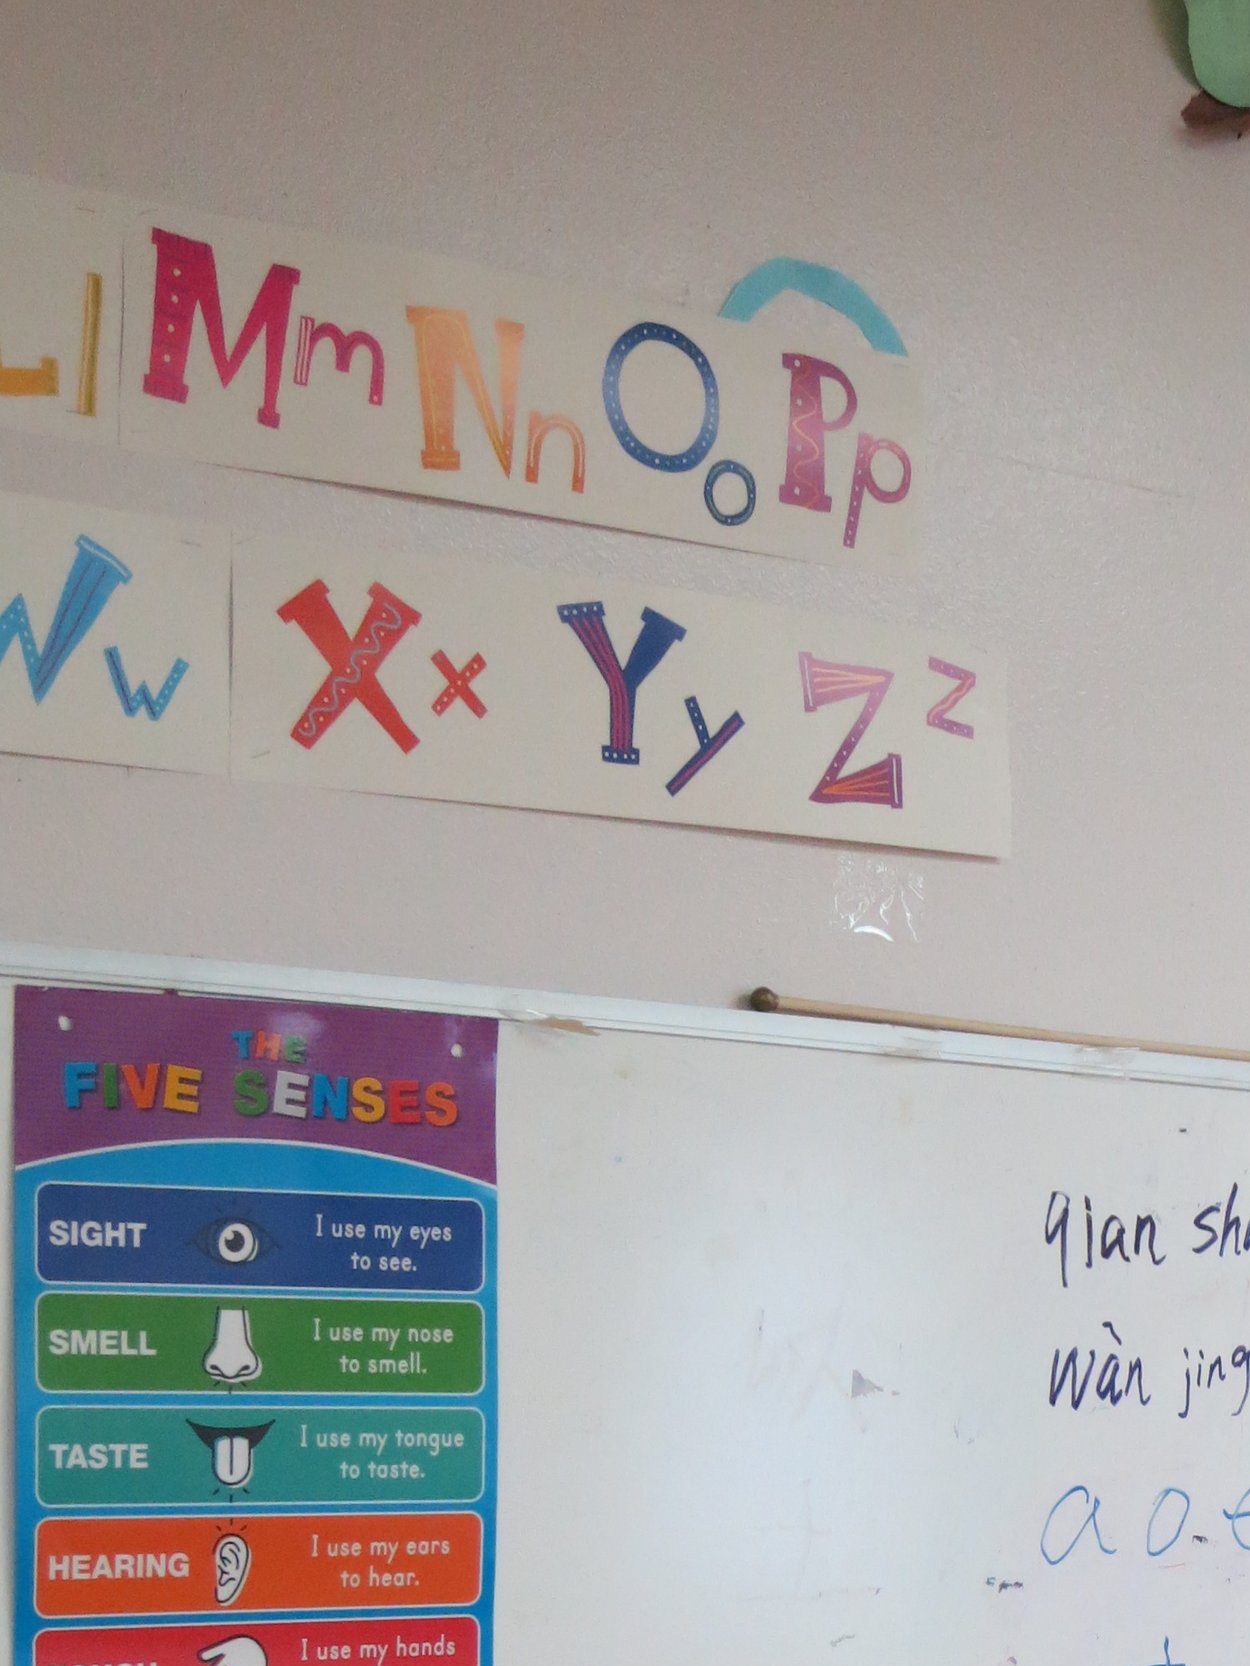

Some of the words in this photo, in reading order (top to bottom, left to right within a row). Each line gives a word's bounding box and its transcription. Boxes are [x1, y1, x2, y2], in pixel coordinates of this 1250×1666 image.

[232, 1029, 308, 1063] THE
[62, 1061, 202, 1114] FIVE
[232, 1069, 458, 1127] SENSES
[48, 1219, 147, 1248] SIGHT
[316, 1214, 323, 1237] I
[332, 1223, 366, 1238] use
[374, 1224, 402, 1248] my
[410, 1225, 452, 1249] eyes
[1045, 1190, 1167, 1288] qian
[351, 1252, 371, 1270] to
[379, 1256, 417, 1271] see.
[49, 1330, 157, 1355] SMELL
[314, 1318, 320, 1341] I
[329, 1327, 364, 1341] use
[372, 1327, 400, 1350] my
[408, 1328, 454, 1343] nose
[339, 1355, 360, 1373] to
[368, 1352, 427, 1374] smell.
[301, 1424, 307, 1447] I
[317, 1433, 350, 1447] use
[359, 1433, 387, 1456] my
[395, 1430, 464, 1456] tongue
[48, 1443, 149, 1469] TASTE
[340, 1461, 360, 1479] to
[368, 1461, 425, 1478] taste.
[1040, 1484, 1118, 1565] a
[1145, 1487, 1191, 1556] o
[312, 1534, 319, 1557] I
[328, 1542, 362, 1556] use
[370, 1542, 399, 1564] my
[406, 1540, 450, 1555] ears
[48, 1553, 190, 1581] HEARING
[340, 1571, 360, 1587] to
[369, 1565, 419, 1587] hear.
[301, 1638, 308, 1660] I
[317, 1645, 351, 1660] use
[360, 1644, 388, 1666] my
[396, 1634, 456, 1657] hands
